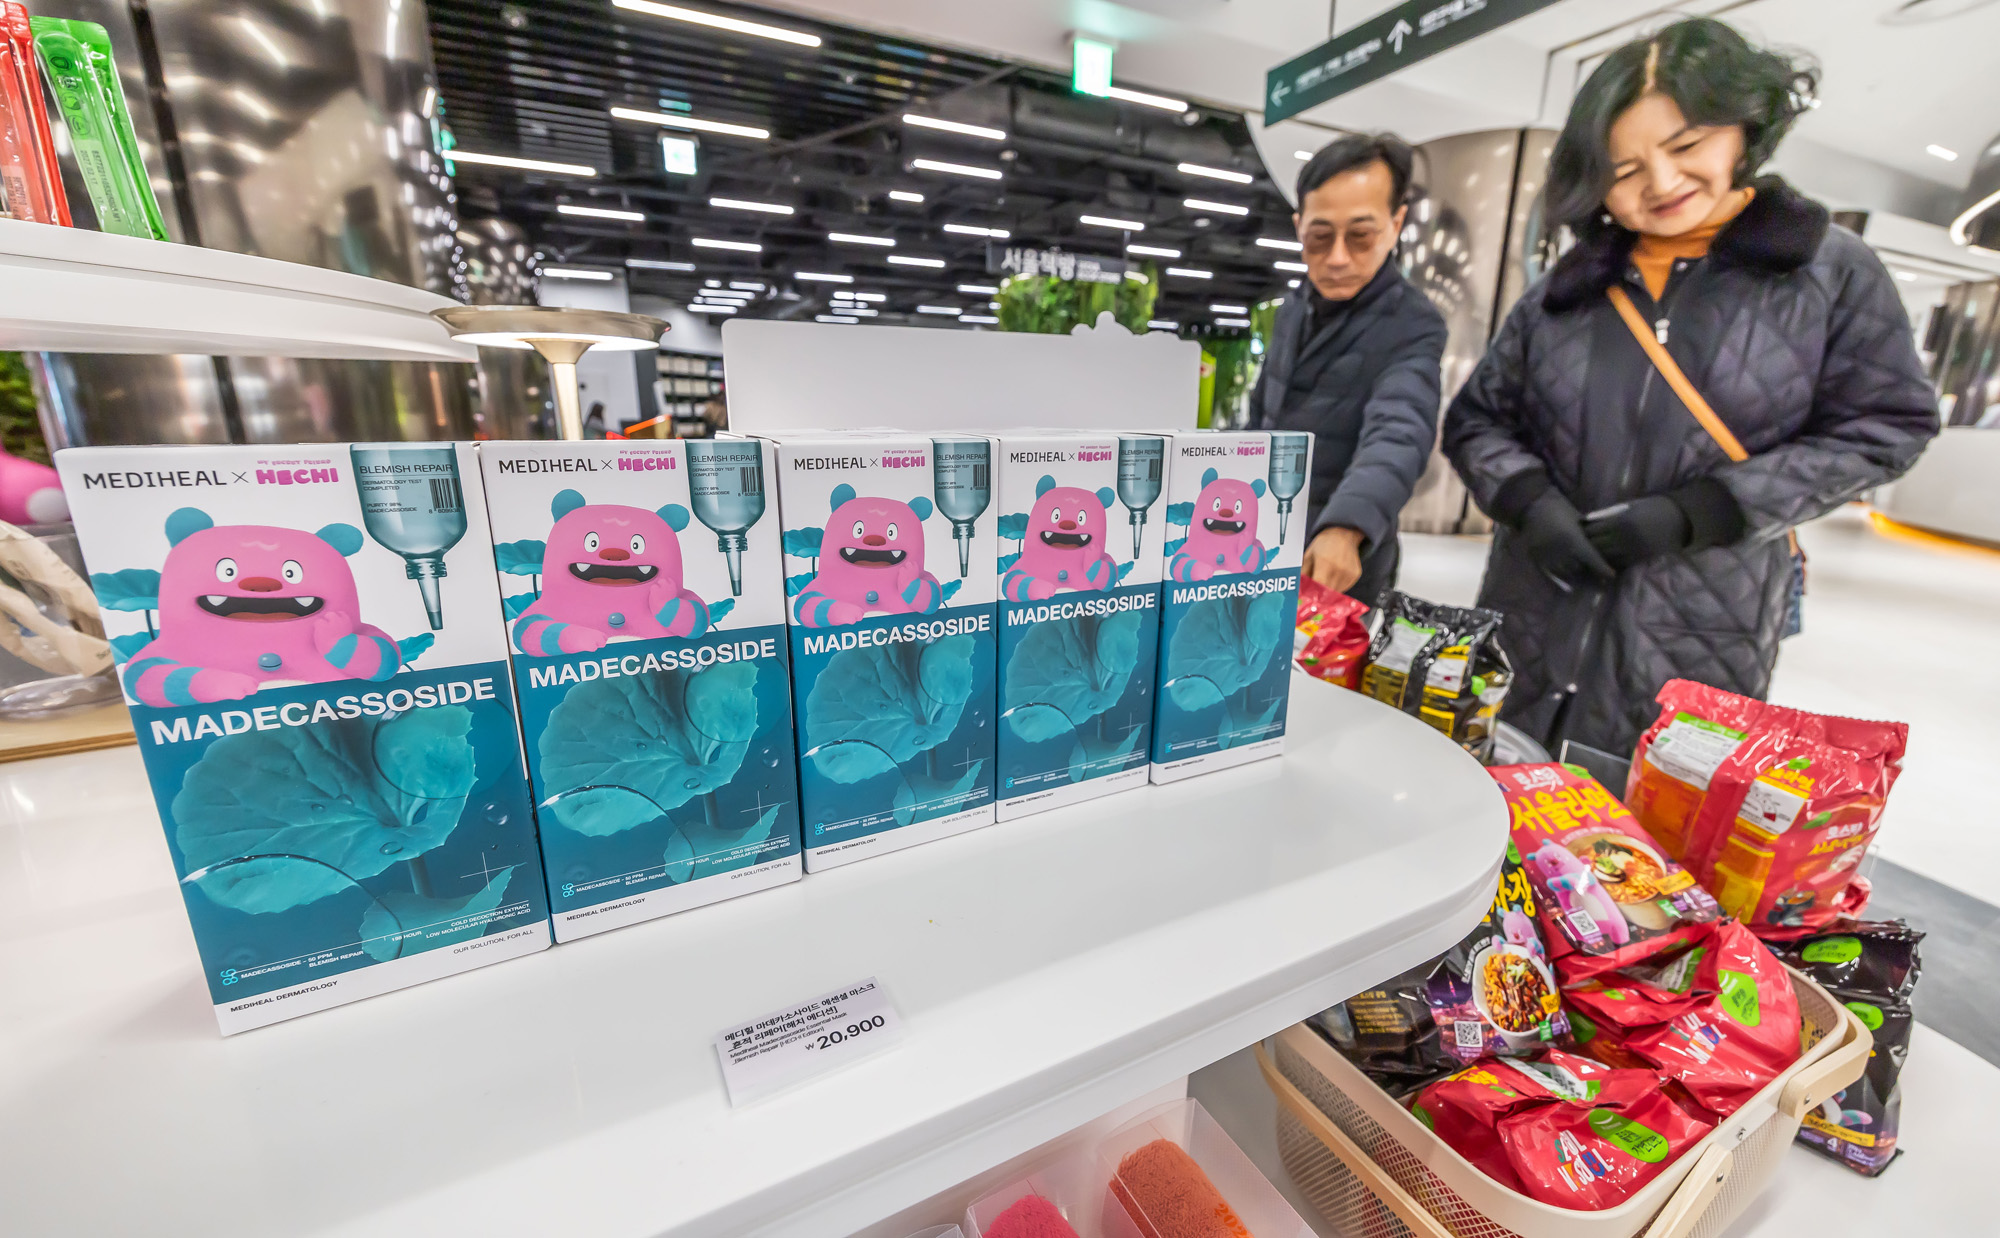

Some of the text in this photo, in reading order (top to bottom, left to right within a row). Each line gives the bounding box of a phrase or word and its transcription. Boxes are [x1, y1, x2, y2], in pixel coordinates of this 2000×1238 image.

[730, 454, 758, 462] REPAIR
[794, 457, 867, 470] MEDIHEAL
[882, 456, 926, 468] HECHI
[1010, 452, 1066, 463] MEDIHEAL
[1078, 450, 1112, 462] HECHI
[1182, 446, 1227, 456] MEDIHEAL
[360, 464, 454, 474] BLEMISH REPAIR
[498, 458, 598, 474] MEDIHEAL
[618, 456, 676, 472] HECHI
[82, 470, 227, 489] MEDIHEAL
[256, 468, 339, 486] HECHI
[1172, 576, 1297, 604] MADECASSOSIDE
[1007, 592, 1156, 626] MADECASSOSIDE
[804, 614, 990, 656] MADECASSOSIDE
[528, 638, 777, 690] MADECASSOSIDE
[150, 677, 496, 746] MADECASSOSIDE
[1510, 780, 1632, 834] 서울라면
[731, 872, 743, 880] OUR
[451, 919, 468, 927] COLD
[504, 903, 530, 914] EXTRACT
[566, 898, 646, 922] MEDIHEAL DERMATOLOGY
[403, 930, 422, 939] HOUR
[426, 908, 531, 939] LOW MOLECULAR HYALURONIC ACID
[454, 946, 469, 954] OUR
[507, 932, 521, 941] FOR
[240, 960, 302, 979] MADECASSOSIDE
[317, 952, 333, 960] PPM
[308, 950, 364, 968] BLEMISH REPAIR
[230, 980, 338, 1012] MEDIHEAL DERMATOLOGY
[725, 983, 876, 1042] 메디힐 마데카소사이드 에센셜 마스크
[831, 1011, 848, 1022] Mask
[816, 1015, 886, 1050] 20,900
